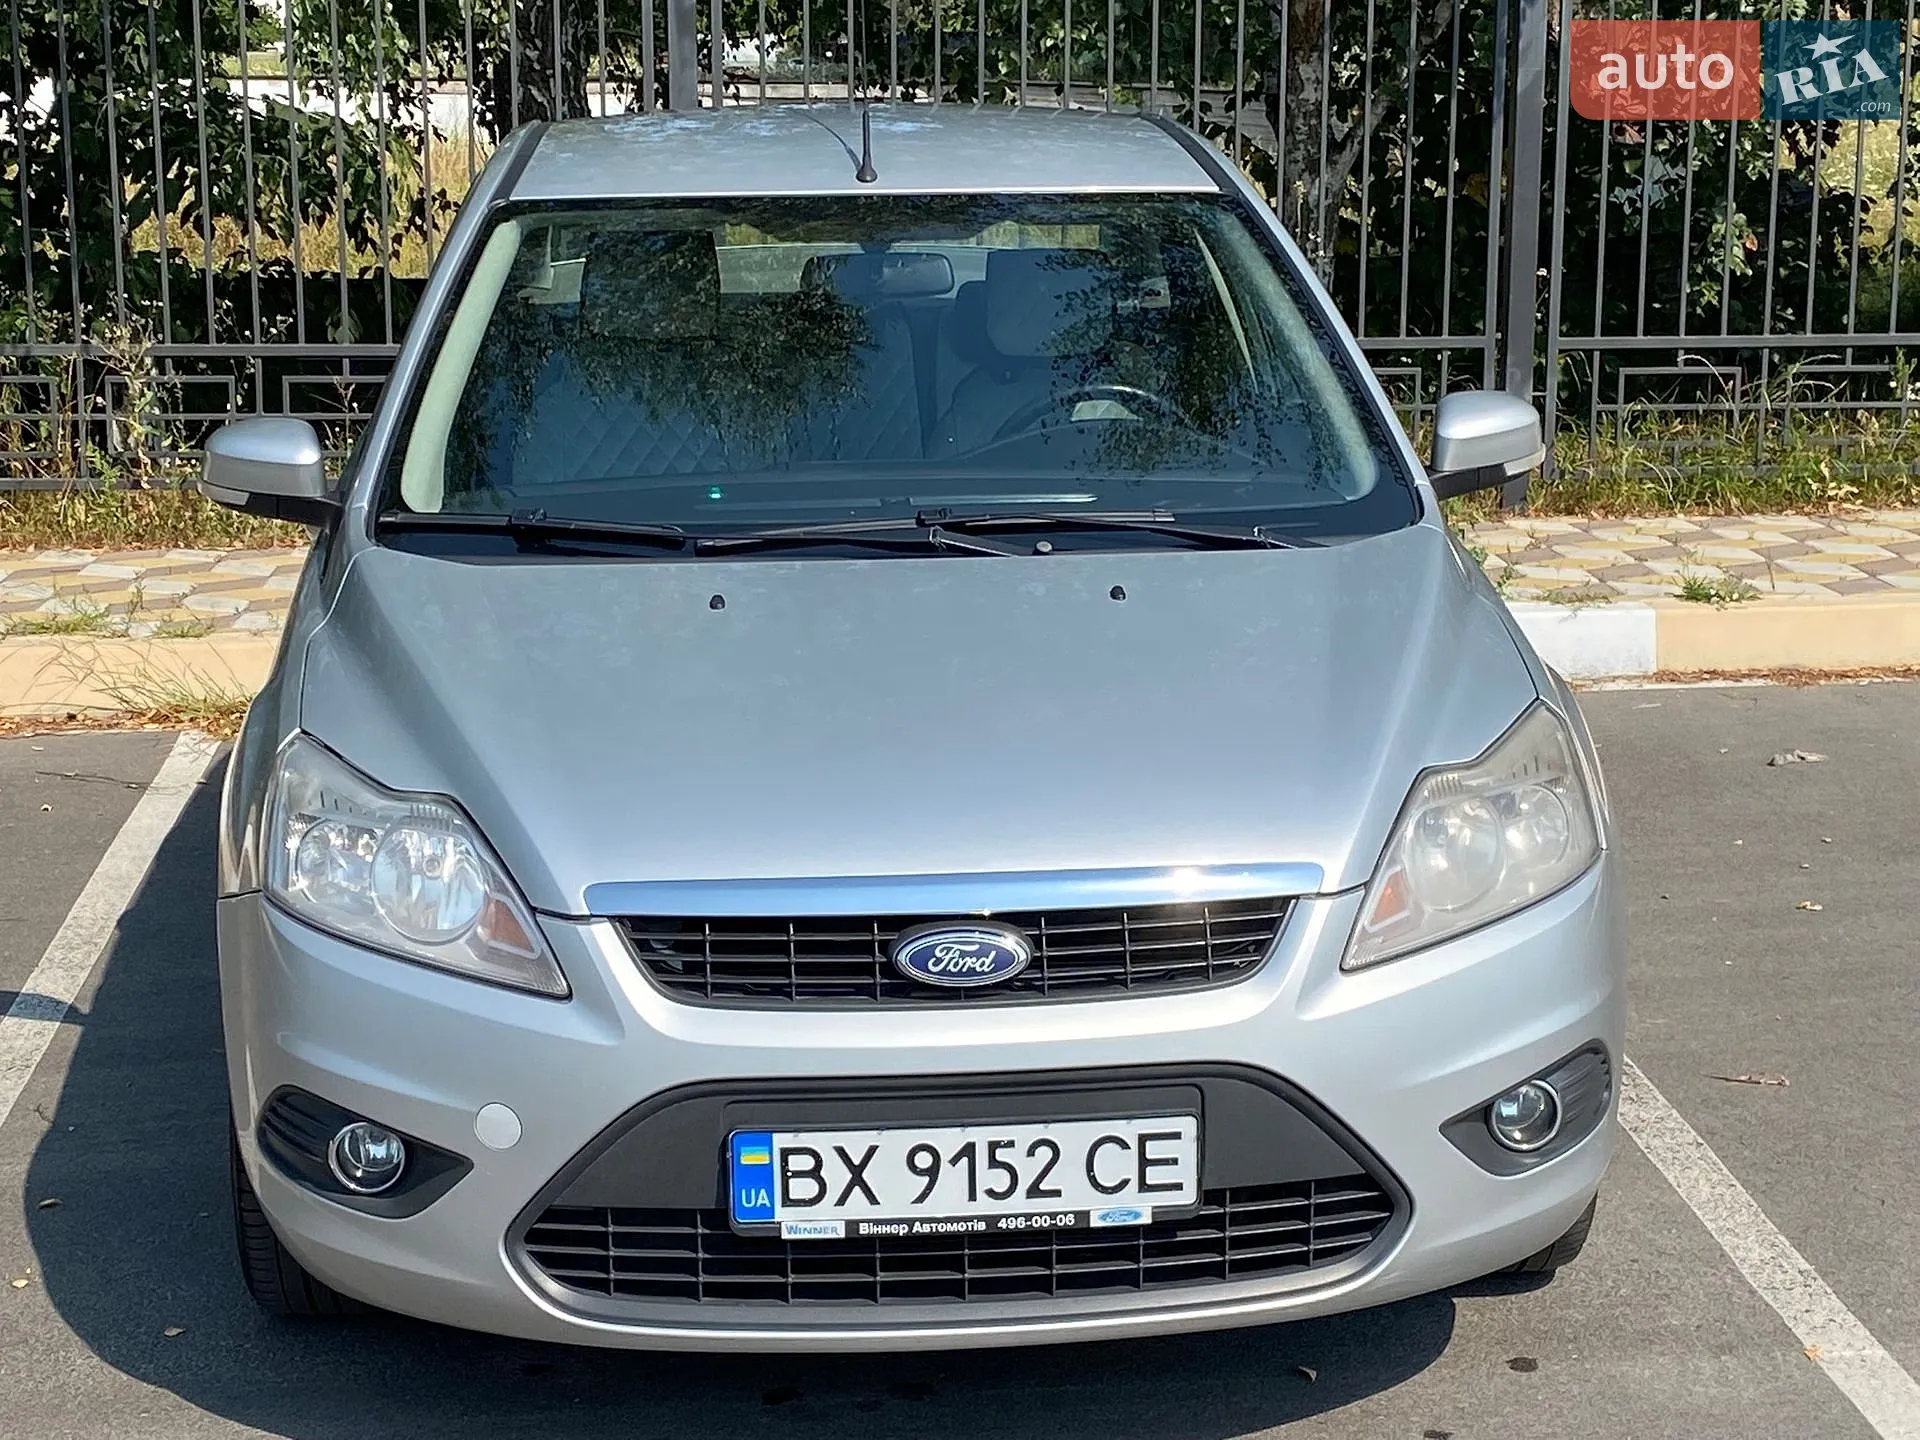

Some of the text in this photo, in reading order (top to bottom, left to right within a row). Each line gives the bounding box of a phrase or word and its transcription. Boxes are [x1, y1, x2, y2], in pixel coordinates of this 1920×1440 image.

[927, 943, 996, 973] Ford
[779, 1131, 1184, 1208] BX 9152 CE
[741, 1188, 772, 1209] UA
[997, 1213, 1076, 1230] 496-00-06
